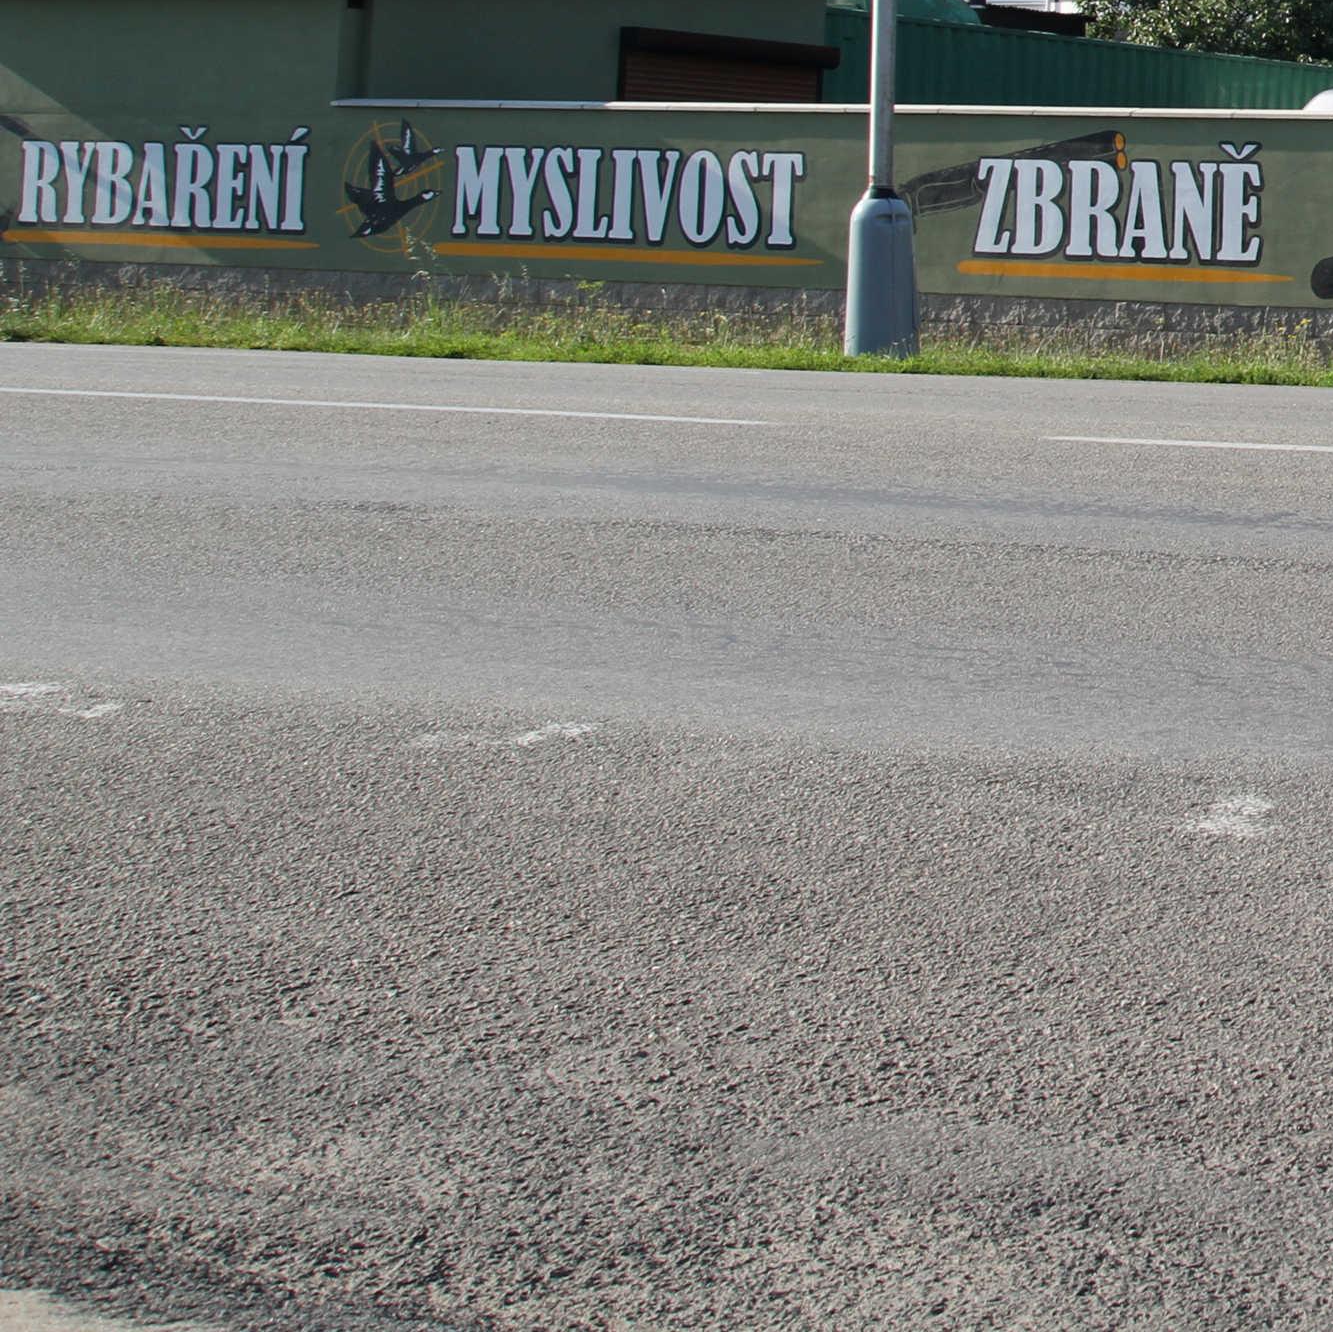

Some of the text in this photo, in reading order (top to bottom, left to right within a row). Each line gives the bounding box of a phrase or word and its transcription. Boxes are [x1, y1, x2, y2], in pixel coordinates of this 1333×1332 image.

[17, 126, 310, 232] RYBAŘENÍ
[451, 146, 805, 246] MYSLIVOST
[973, 143, 1262, 263] ZBRANĚ
